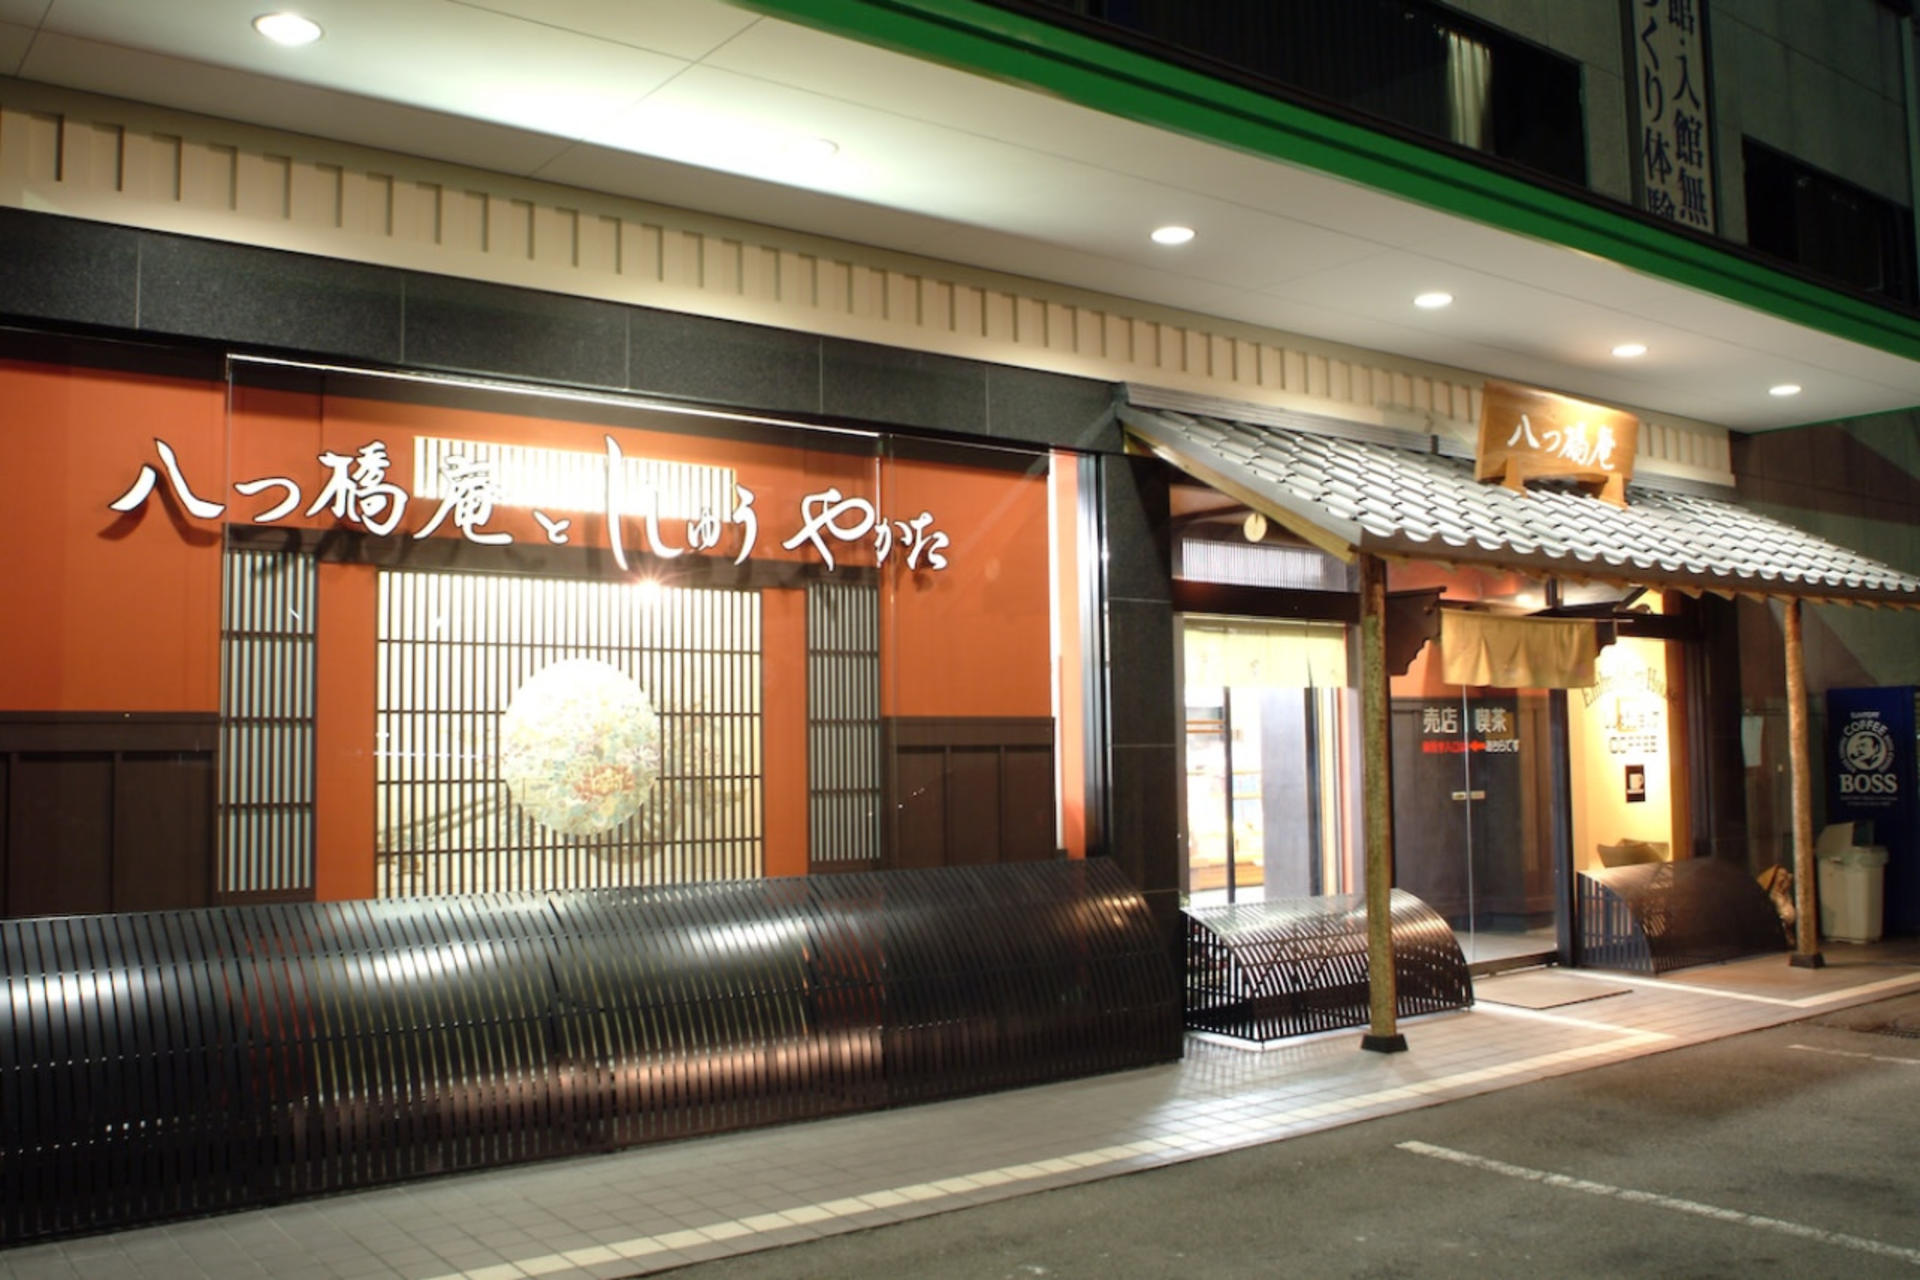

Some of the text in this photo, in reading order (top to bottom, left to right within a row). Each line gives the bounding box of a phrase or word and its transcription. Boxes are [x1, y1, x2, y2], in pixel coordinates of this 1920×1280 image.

[1642, 0, 1675, 220] くり体験
[1423, 706, 1507, 734] 売店 喫茶
[1843, 719, 1888, 737] COFFEE
[1839, 773, 1898, 794] BOSS
